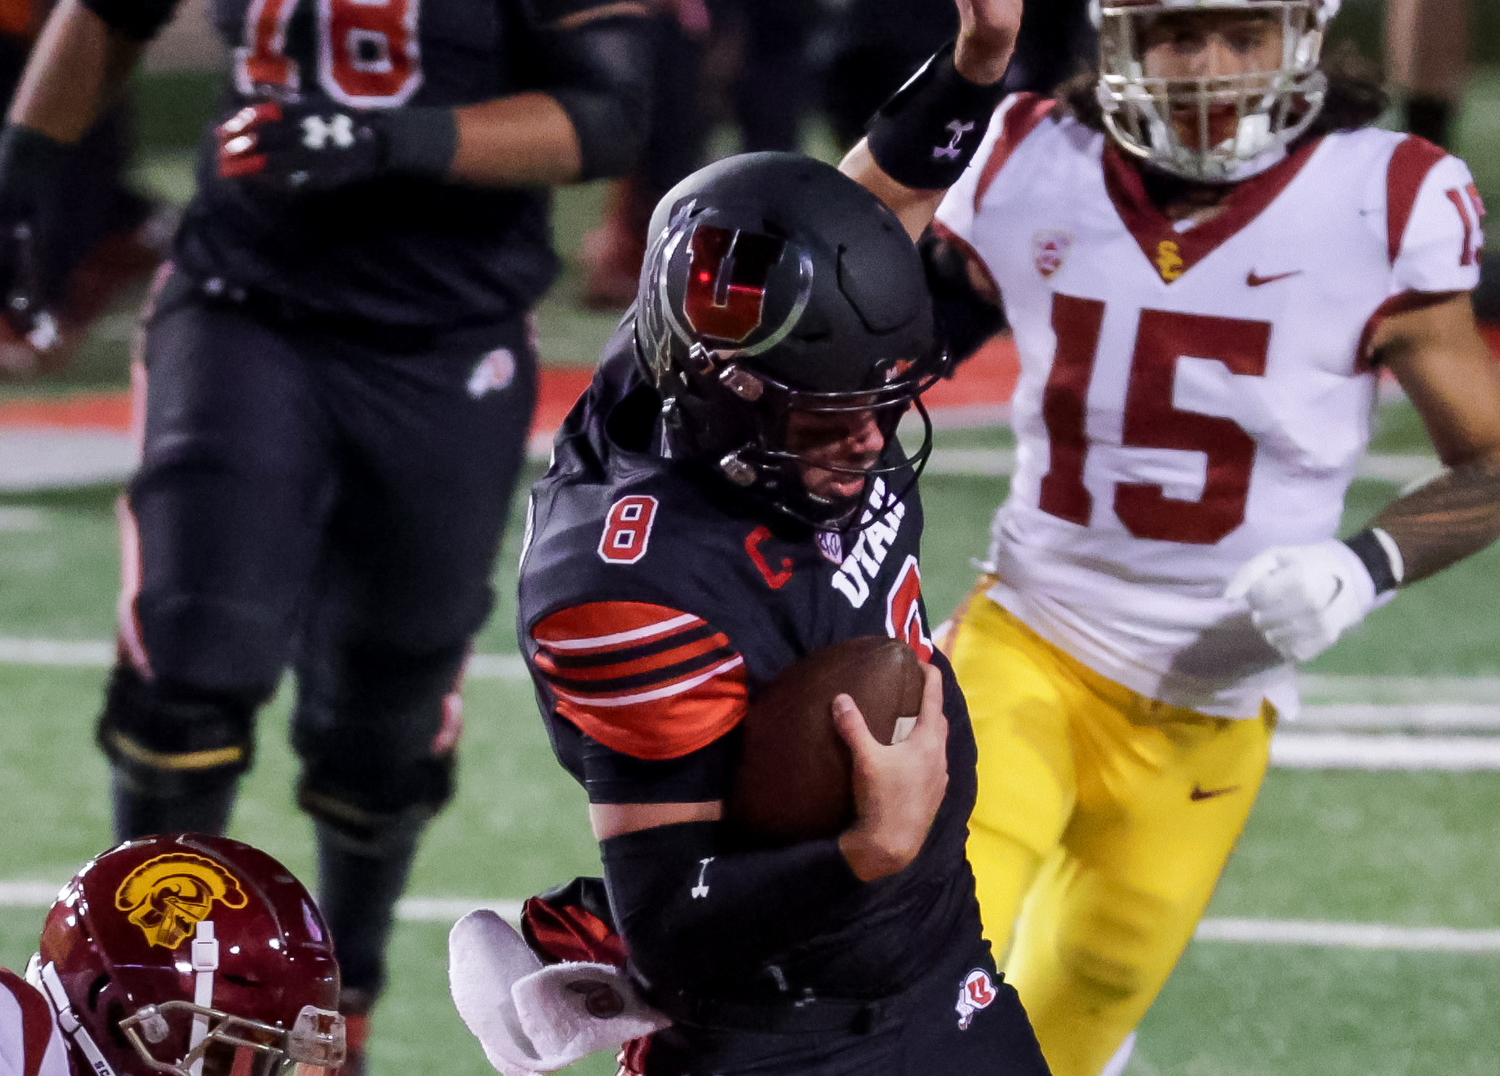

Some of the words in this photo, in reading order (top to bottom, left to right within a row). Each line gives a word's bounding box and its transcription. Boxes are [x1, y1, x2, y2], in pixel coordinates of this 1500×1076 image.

[683, 223, 789, 343] U
[1039, 292, 1273, 545] 15
[597, 495, 659, 564] 8
[745, 526, 792, 589] C
[831, 476, 905, 608] UTAH
[967, 975, 992, 1005] U
